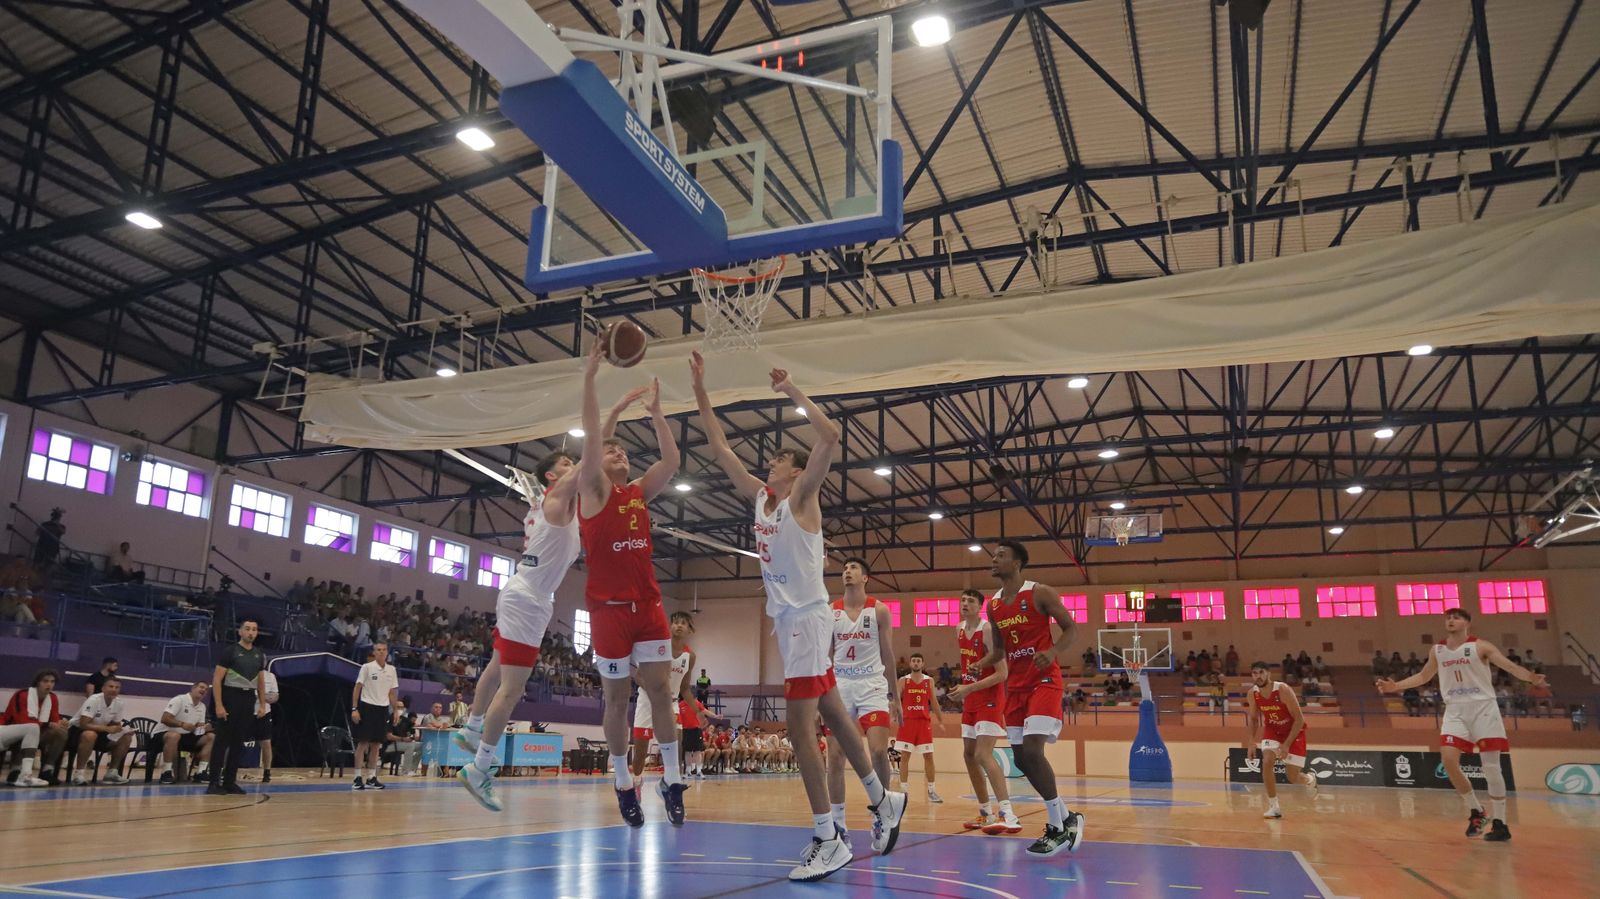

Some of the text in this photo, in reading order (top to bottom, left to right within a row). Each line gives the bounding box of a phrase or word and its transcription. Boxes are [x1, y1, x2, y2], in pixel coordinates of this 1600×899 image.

[625, 111, 706, 210] SPORT SYSTEM
[629, 513, 639, 530] 2
[757, 541, 772, 563] 15
[1131, 597, 1144, 610] 10
[996, 614, 1029, 630] ESPAÑA
[836, 630, 871, 641] ESPAÑA
[1010, 630, 1019, 645] 5
[846, 645, 856, 661] 4
[1442, 657, 1471, 668] ESPAÑA
[1454, 669, 1463, 682] 11
[916, 695, 922, 703] 9
[1269, 712, 1279, 720] 15
